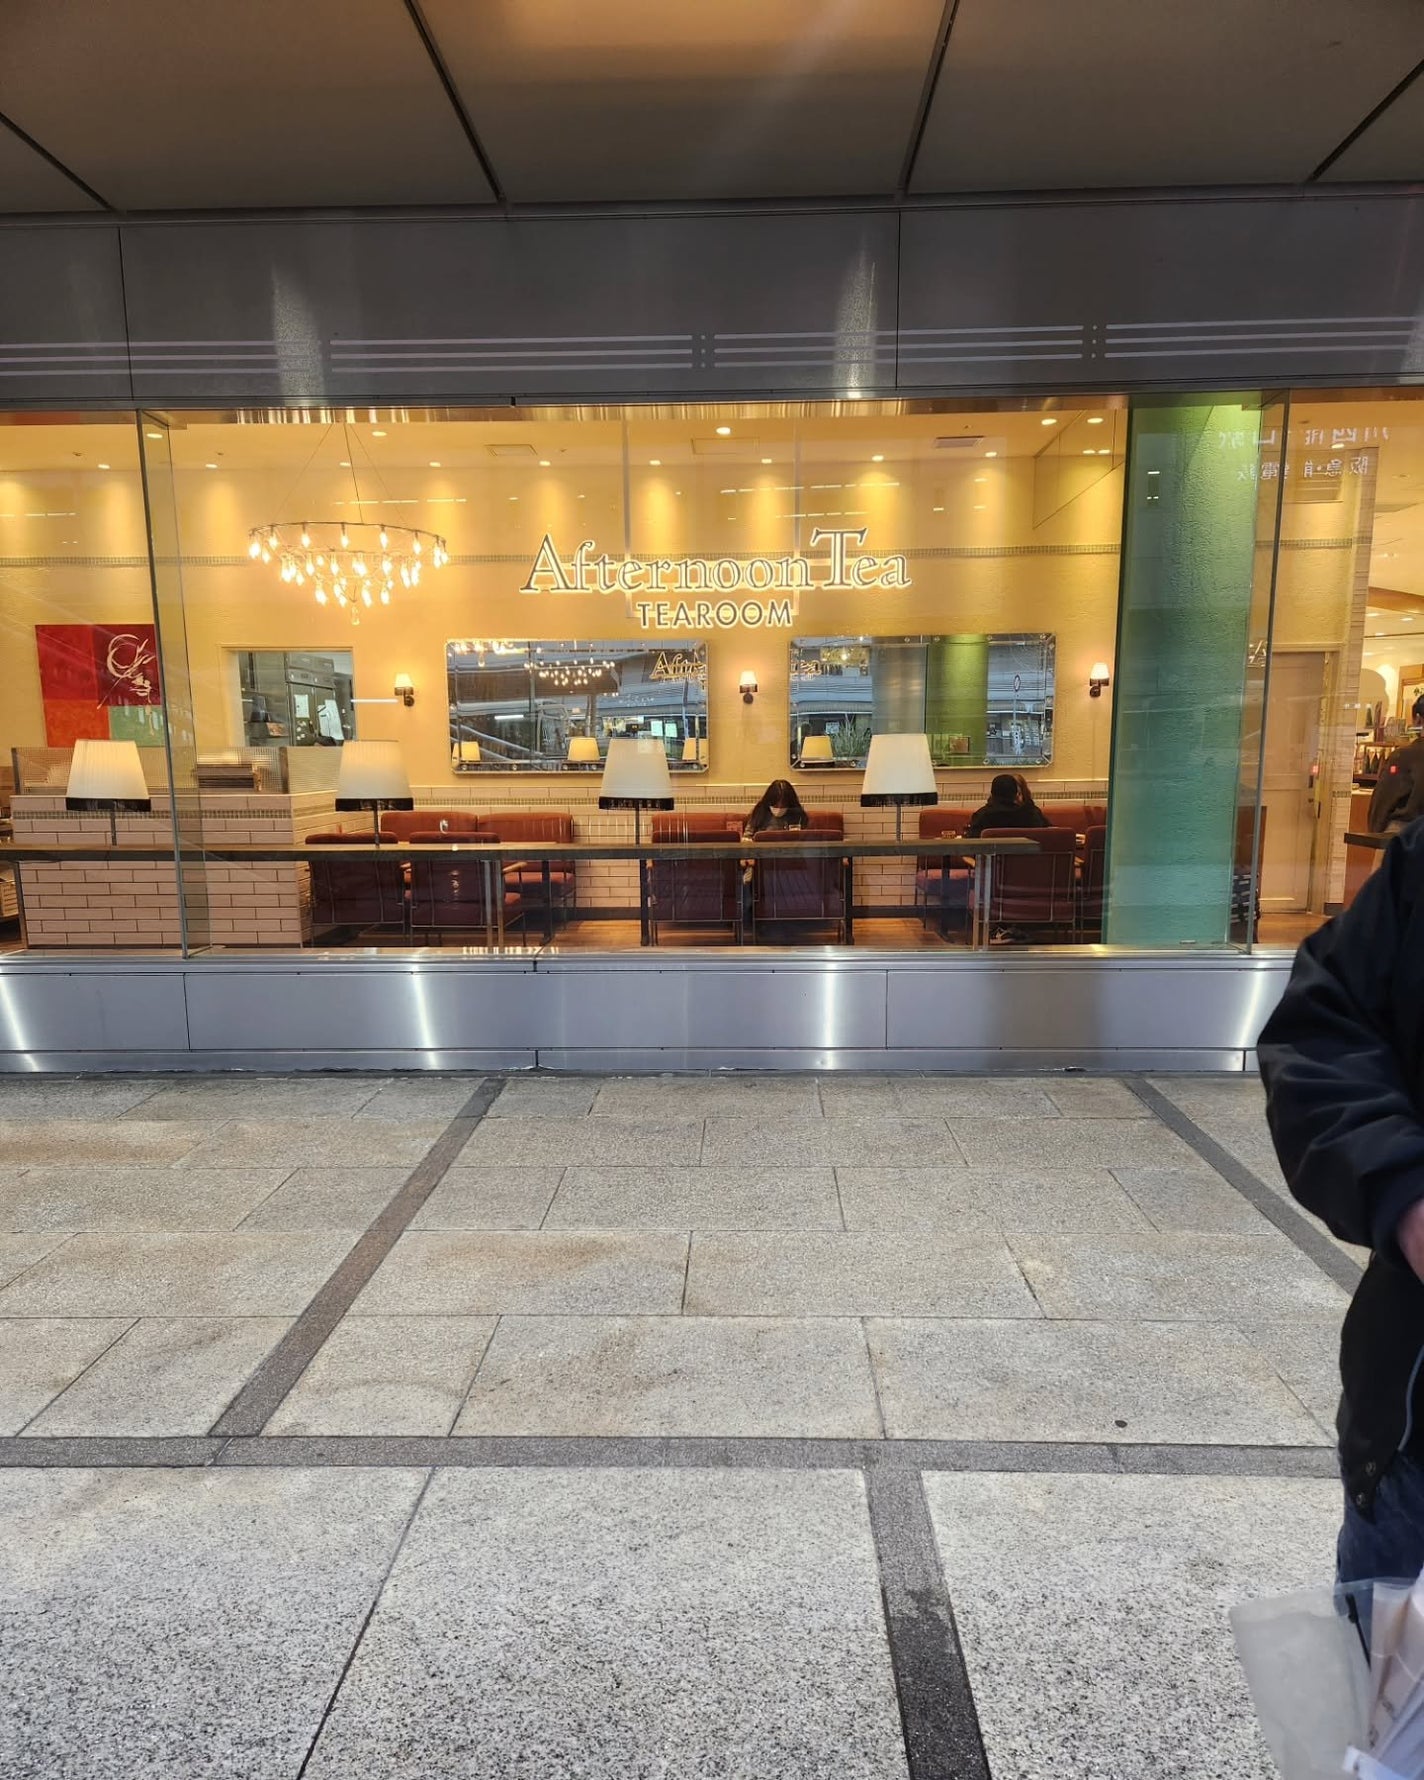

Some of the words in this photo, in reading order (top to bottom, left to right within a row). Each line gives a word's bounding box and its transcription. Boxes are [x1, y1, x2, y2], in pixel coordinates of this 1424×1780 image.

[520, 532, 814, 594] Afternoon
[810, 527, 912, 590] Tea
[636, 599, 793, 629] TEAROOM
